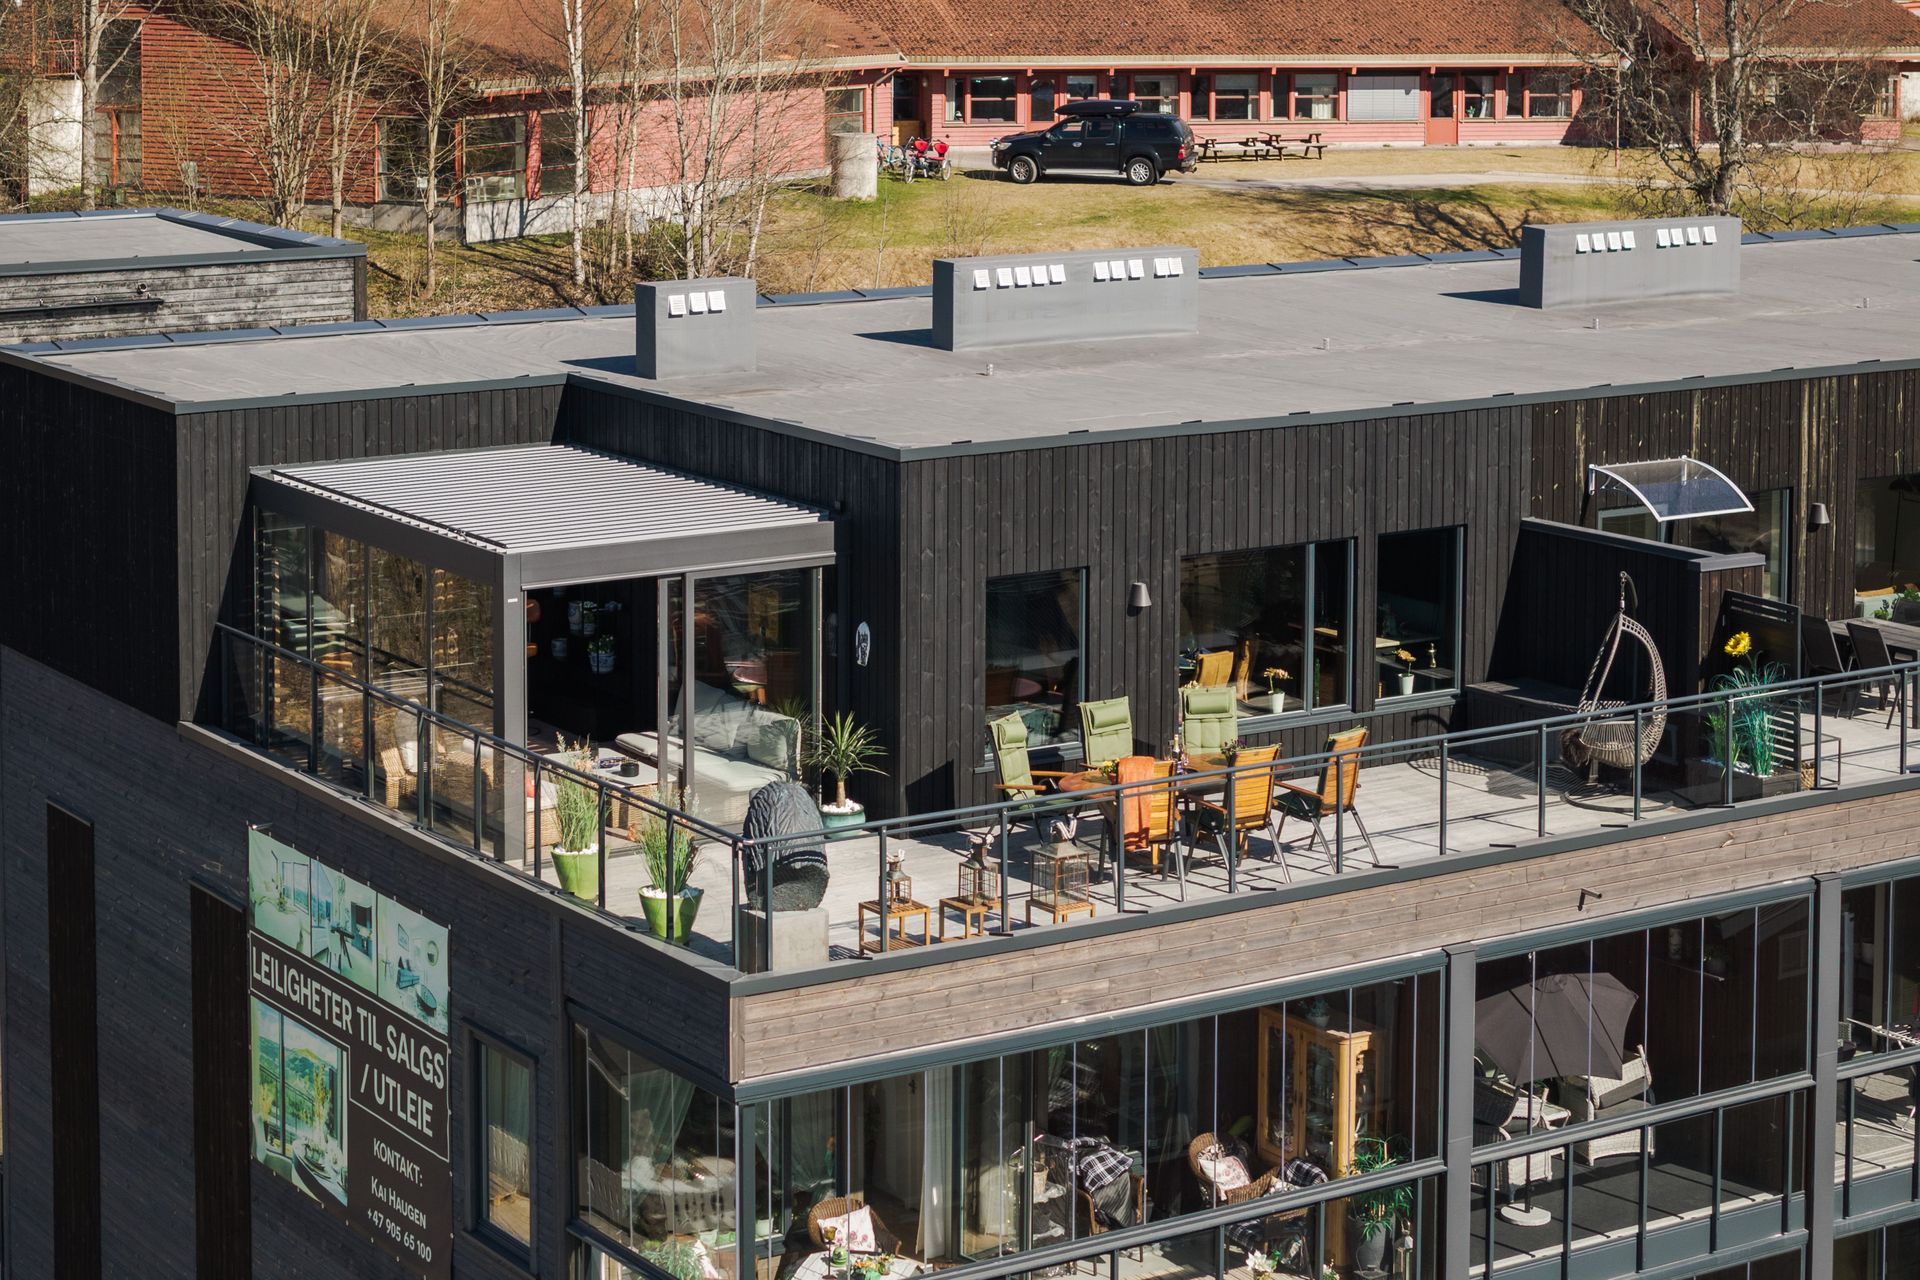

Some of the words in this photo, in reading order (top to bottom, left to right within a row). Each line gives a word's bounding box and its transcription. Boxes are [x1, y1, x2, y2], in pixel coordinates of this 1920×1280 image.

[252, 946, 353, 1035] LEILIGHETER
[356, 1006, 382, 1052] TIL
[386, 1024, 445, 1090] SALGS
[360, 1063, 369, 1093] /
[373, 1068, 433, 1137] UTLEIE
[373, 1138, 423, 1187] KONTAKT:
[367, 1208, 384, 1228] +47
[385, 1218, 401, 1242] 905
[403, 1231, 415, 1251] 65
[416, 1240, 432, 1262] 100
[388, 1187, 427, 1230] HAUGEN
